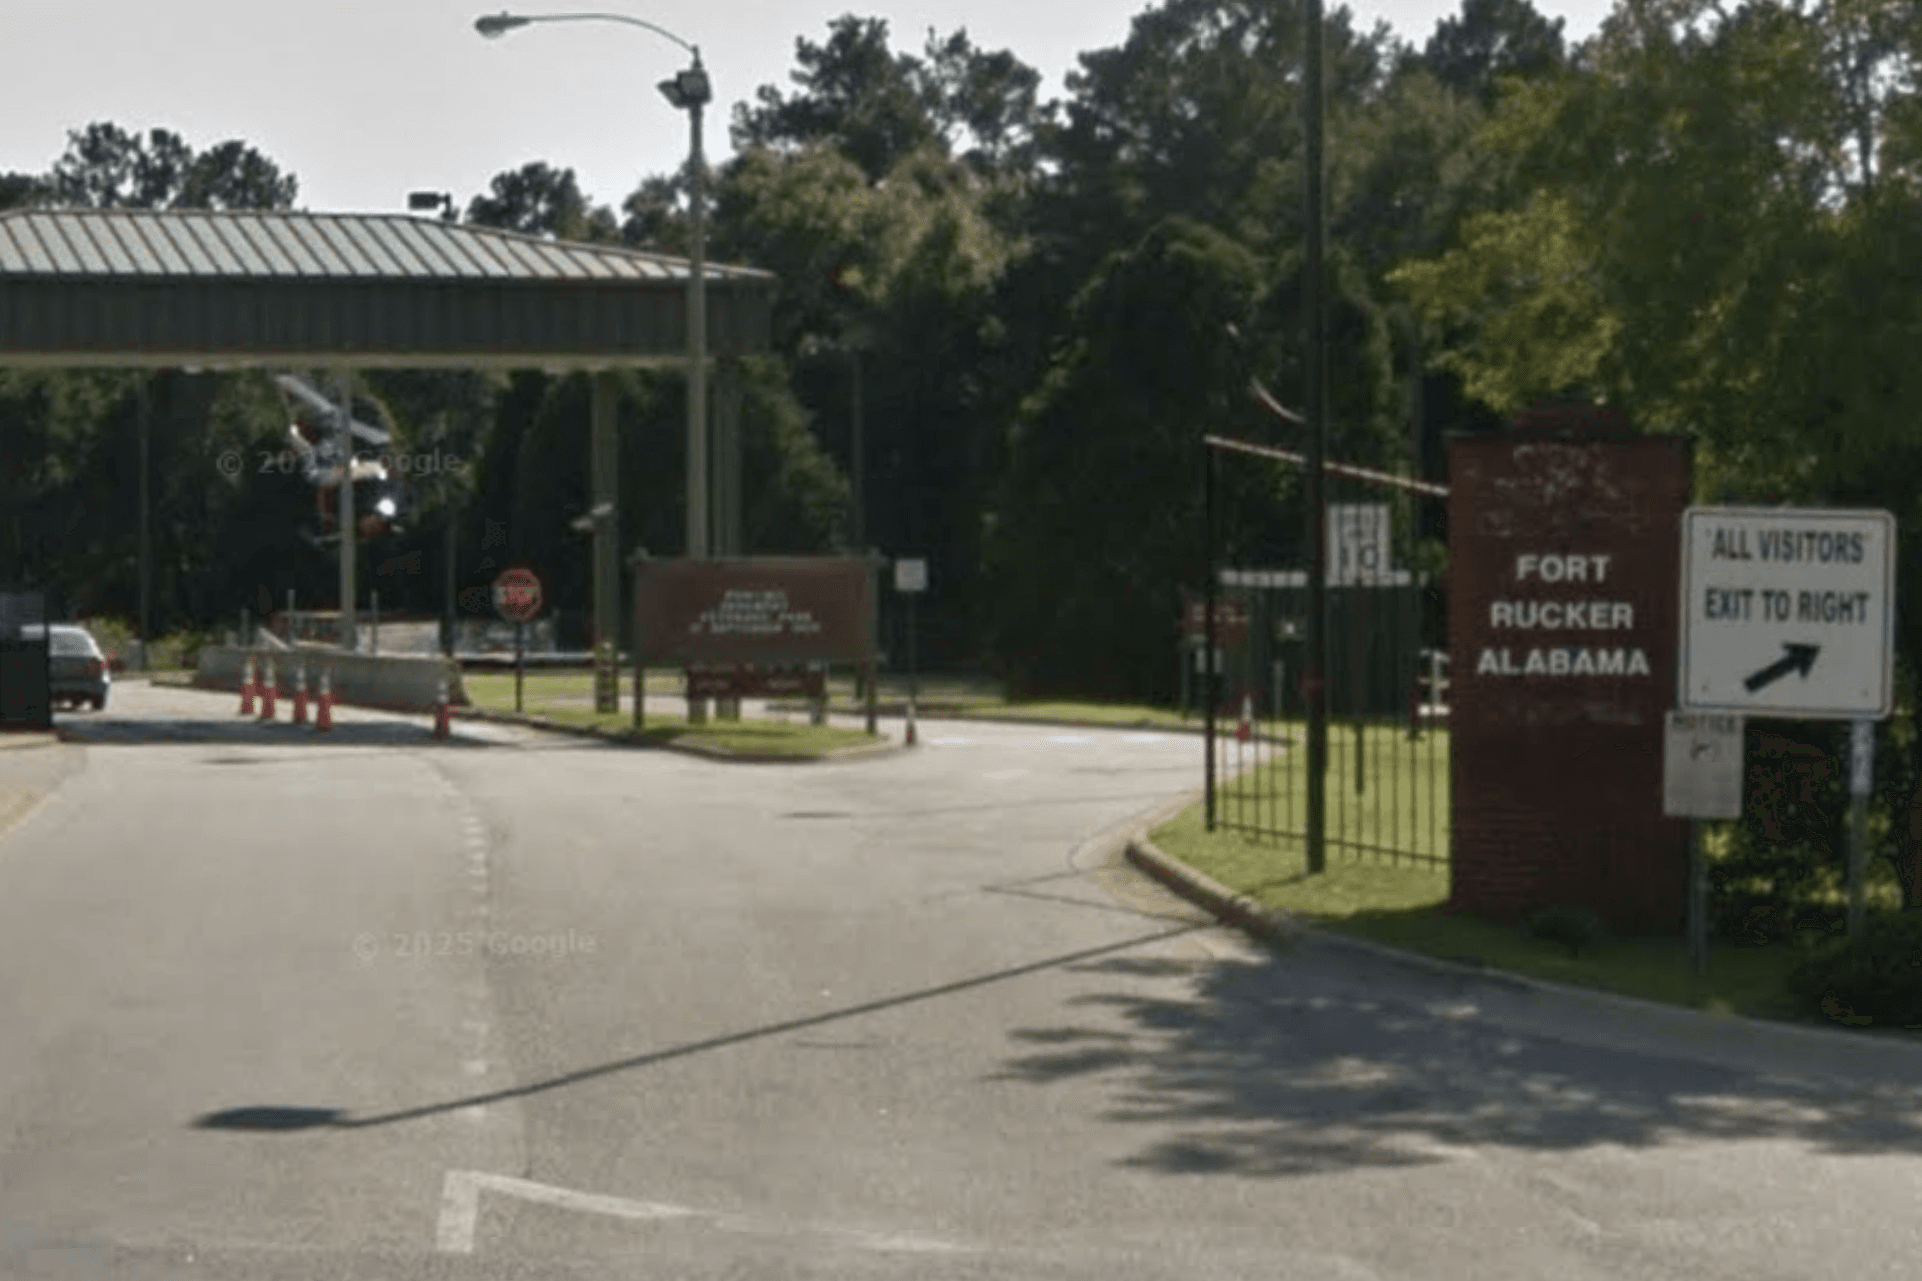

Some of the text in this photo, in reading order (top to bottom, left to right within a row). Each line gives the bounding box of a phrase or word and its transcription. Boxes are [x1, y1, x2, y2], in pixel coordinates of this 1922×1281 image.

[1712, 530, 1865, 564] ALL VISITORS
[1515, 554, 1612, 583] FORT
[1489, 602, 1634, 630] RUCKER
[1704, 588, 1870, 625] EXIT TO RIGHT
[1476, 648, 1651, 676] ALABAMA
